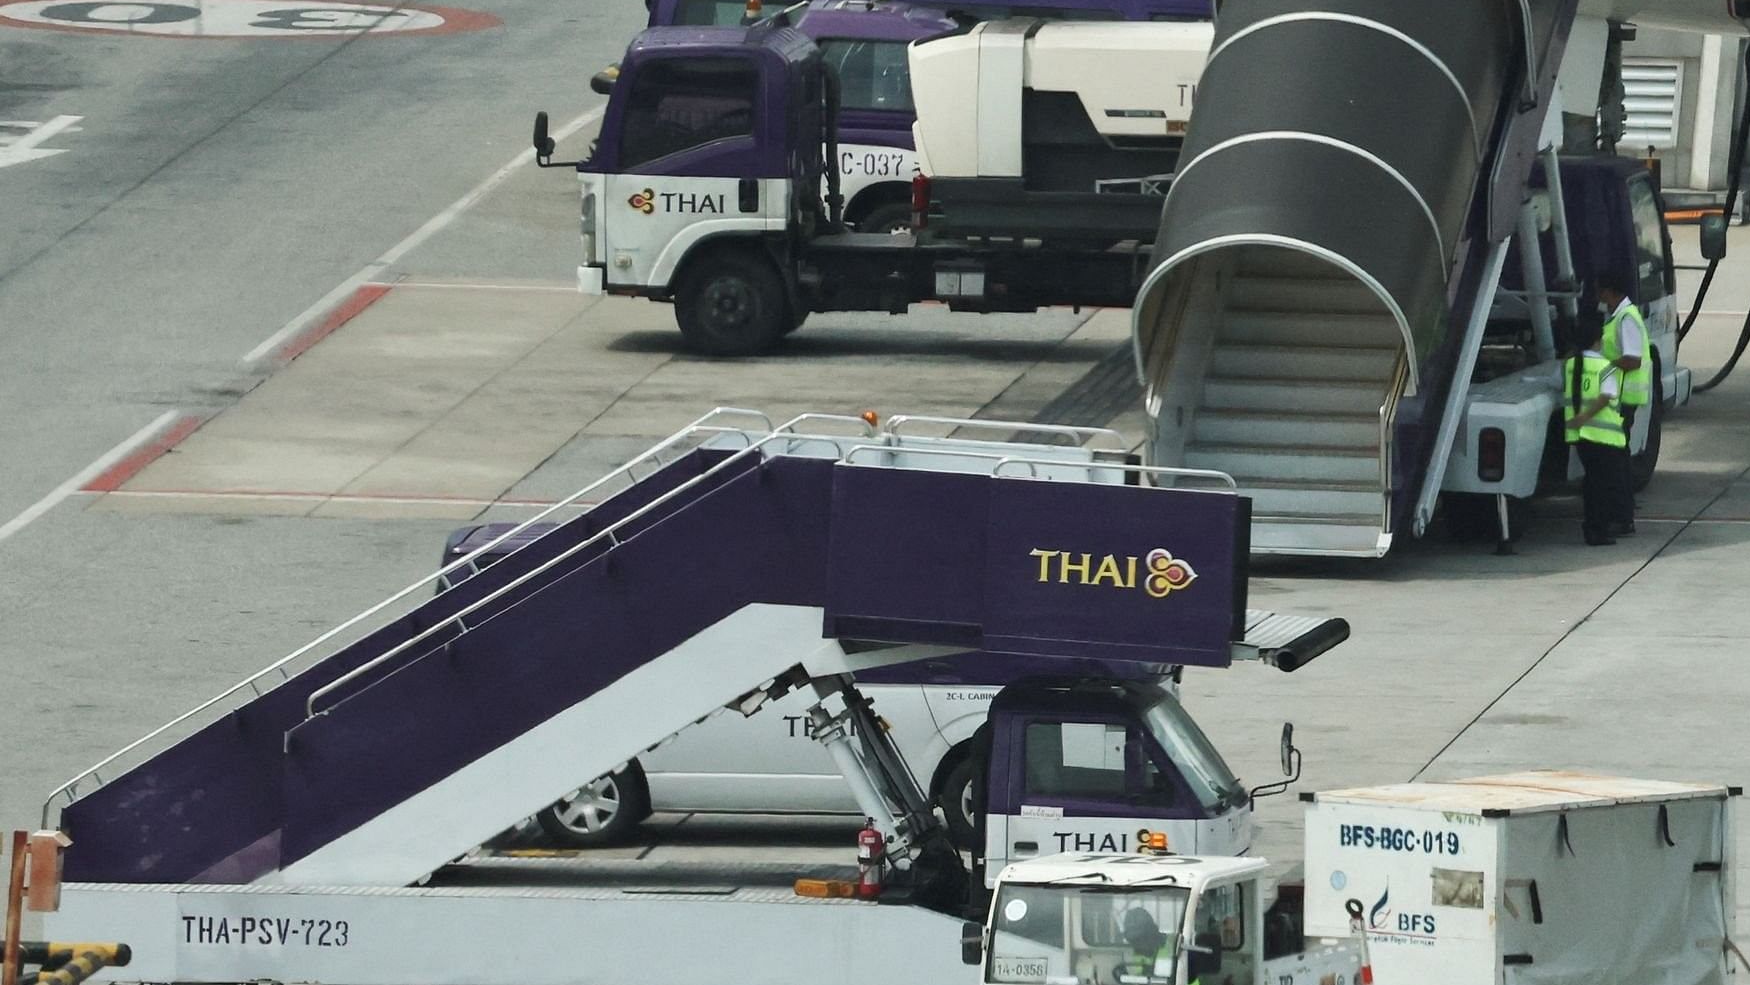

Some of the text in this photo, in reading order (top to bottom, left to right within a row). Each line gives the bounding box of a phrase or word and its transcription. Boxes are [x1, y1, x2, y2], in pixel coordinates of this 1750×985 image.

[660, 193, 725, 213] THAI
[1029, 548, 1138, 588] THAI
[1053, 832, 1128, 853] THAI
[182, 916, 349, 947] THA-PSV-723
[1398, 913, 1436, 934] BFS
